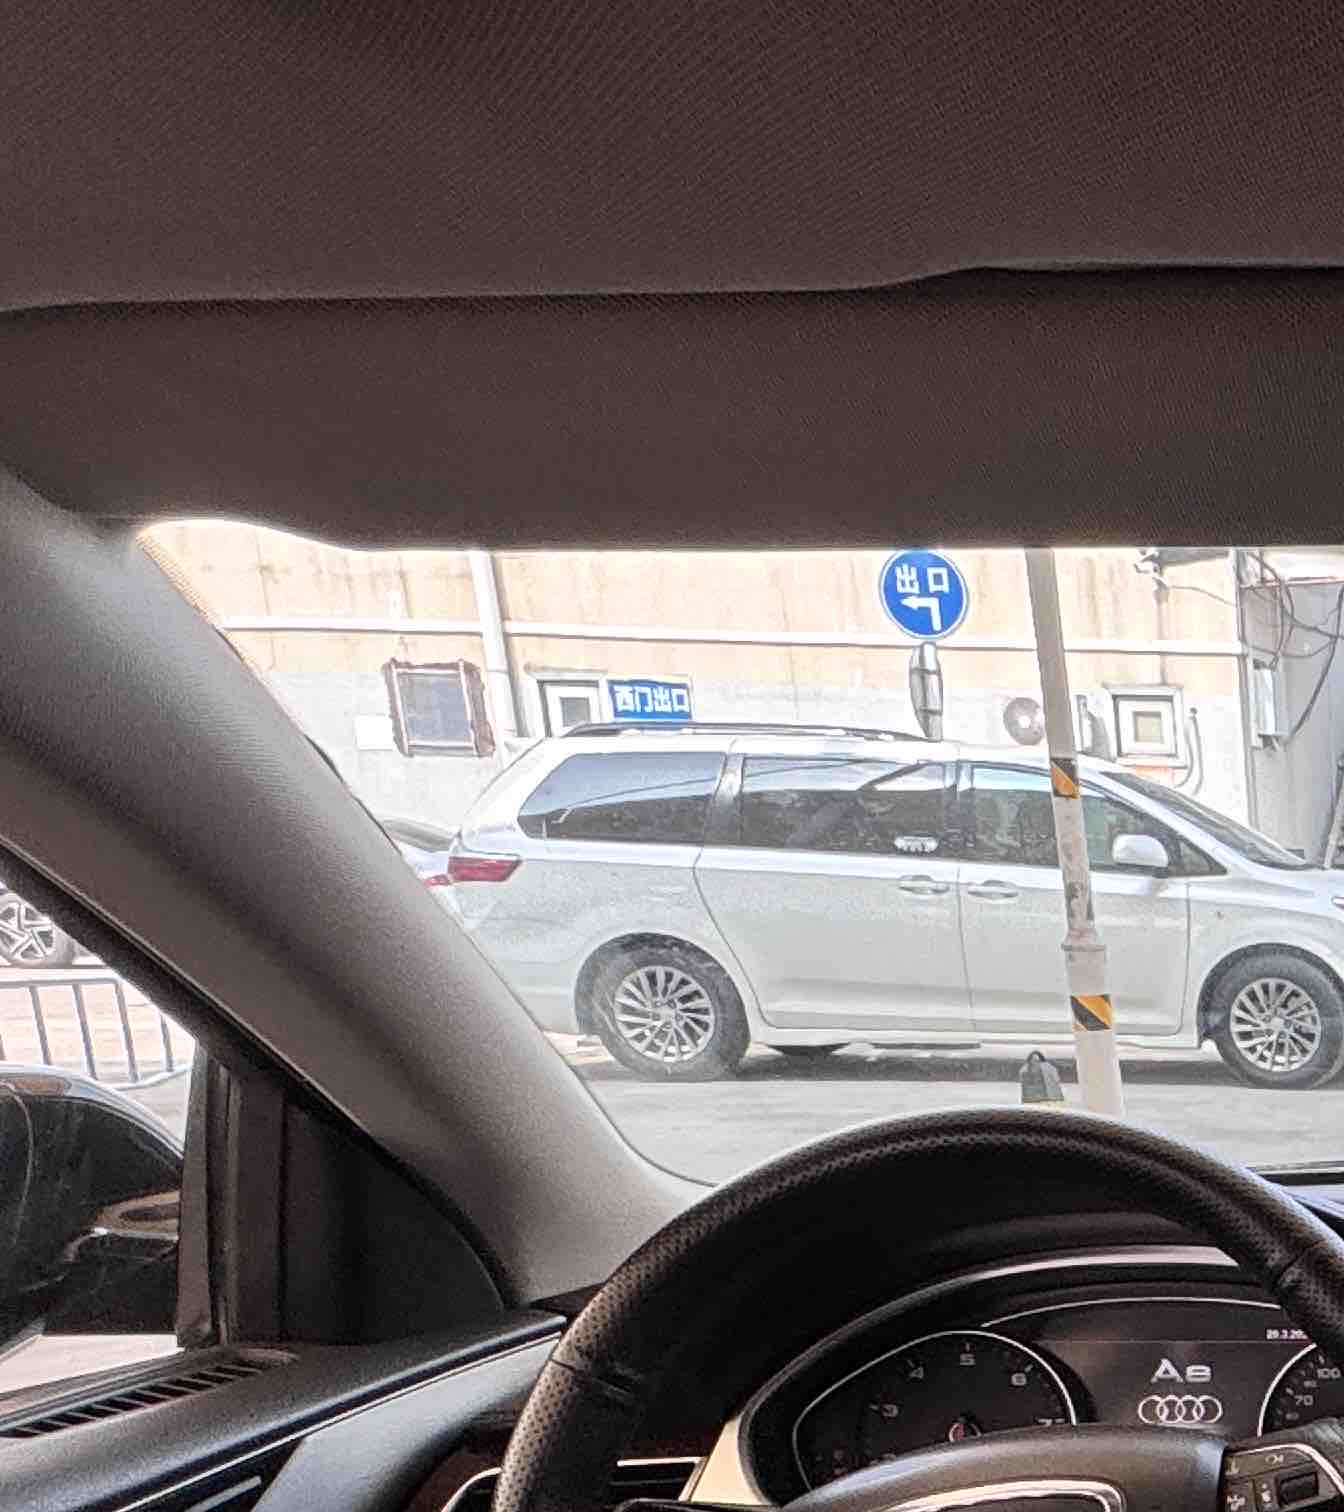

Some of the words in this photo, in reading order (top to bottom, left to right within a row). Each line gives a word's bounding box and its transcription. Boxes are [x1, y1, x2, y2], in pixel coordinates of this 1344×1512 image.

[895, 563, 949, 594] 出口
[613, 685, 690, 712] 西门出口
[959, 1353, 976, 1366] 5
[1151, 1357, 1213, 1384] A8
